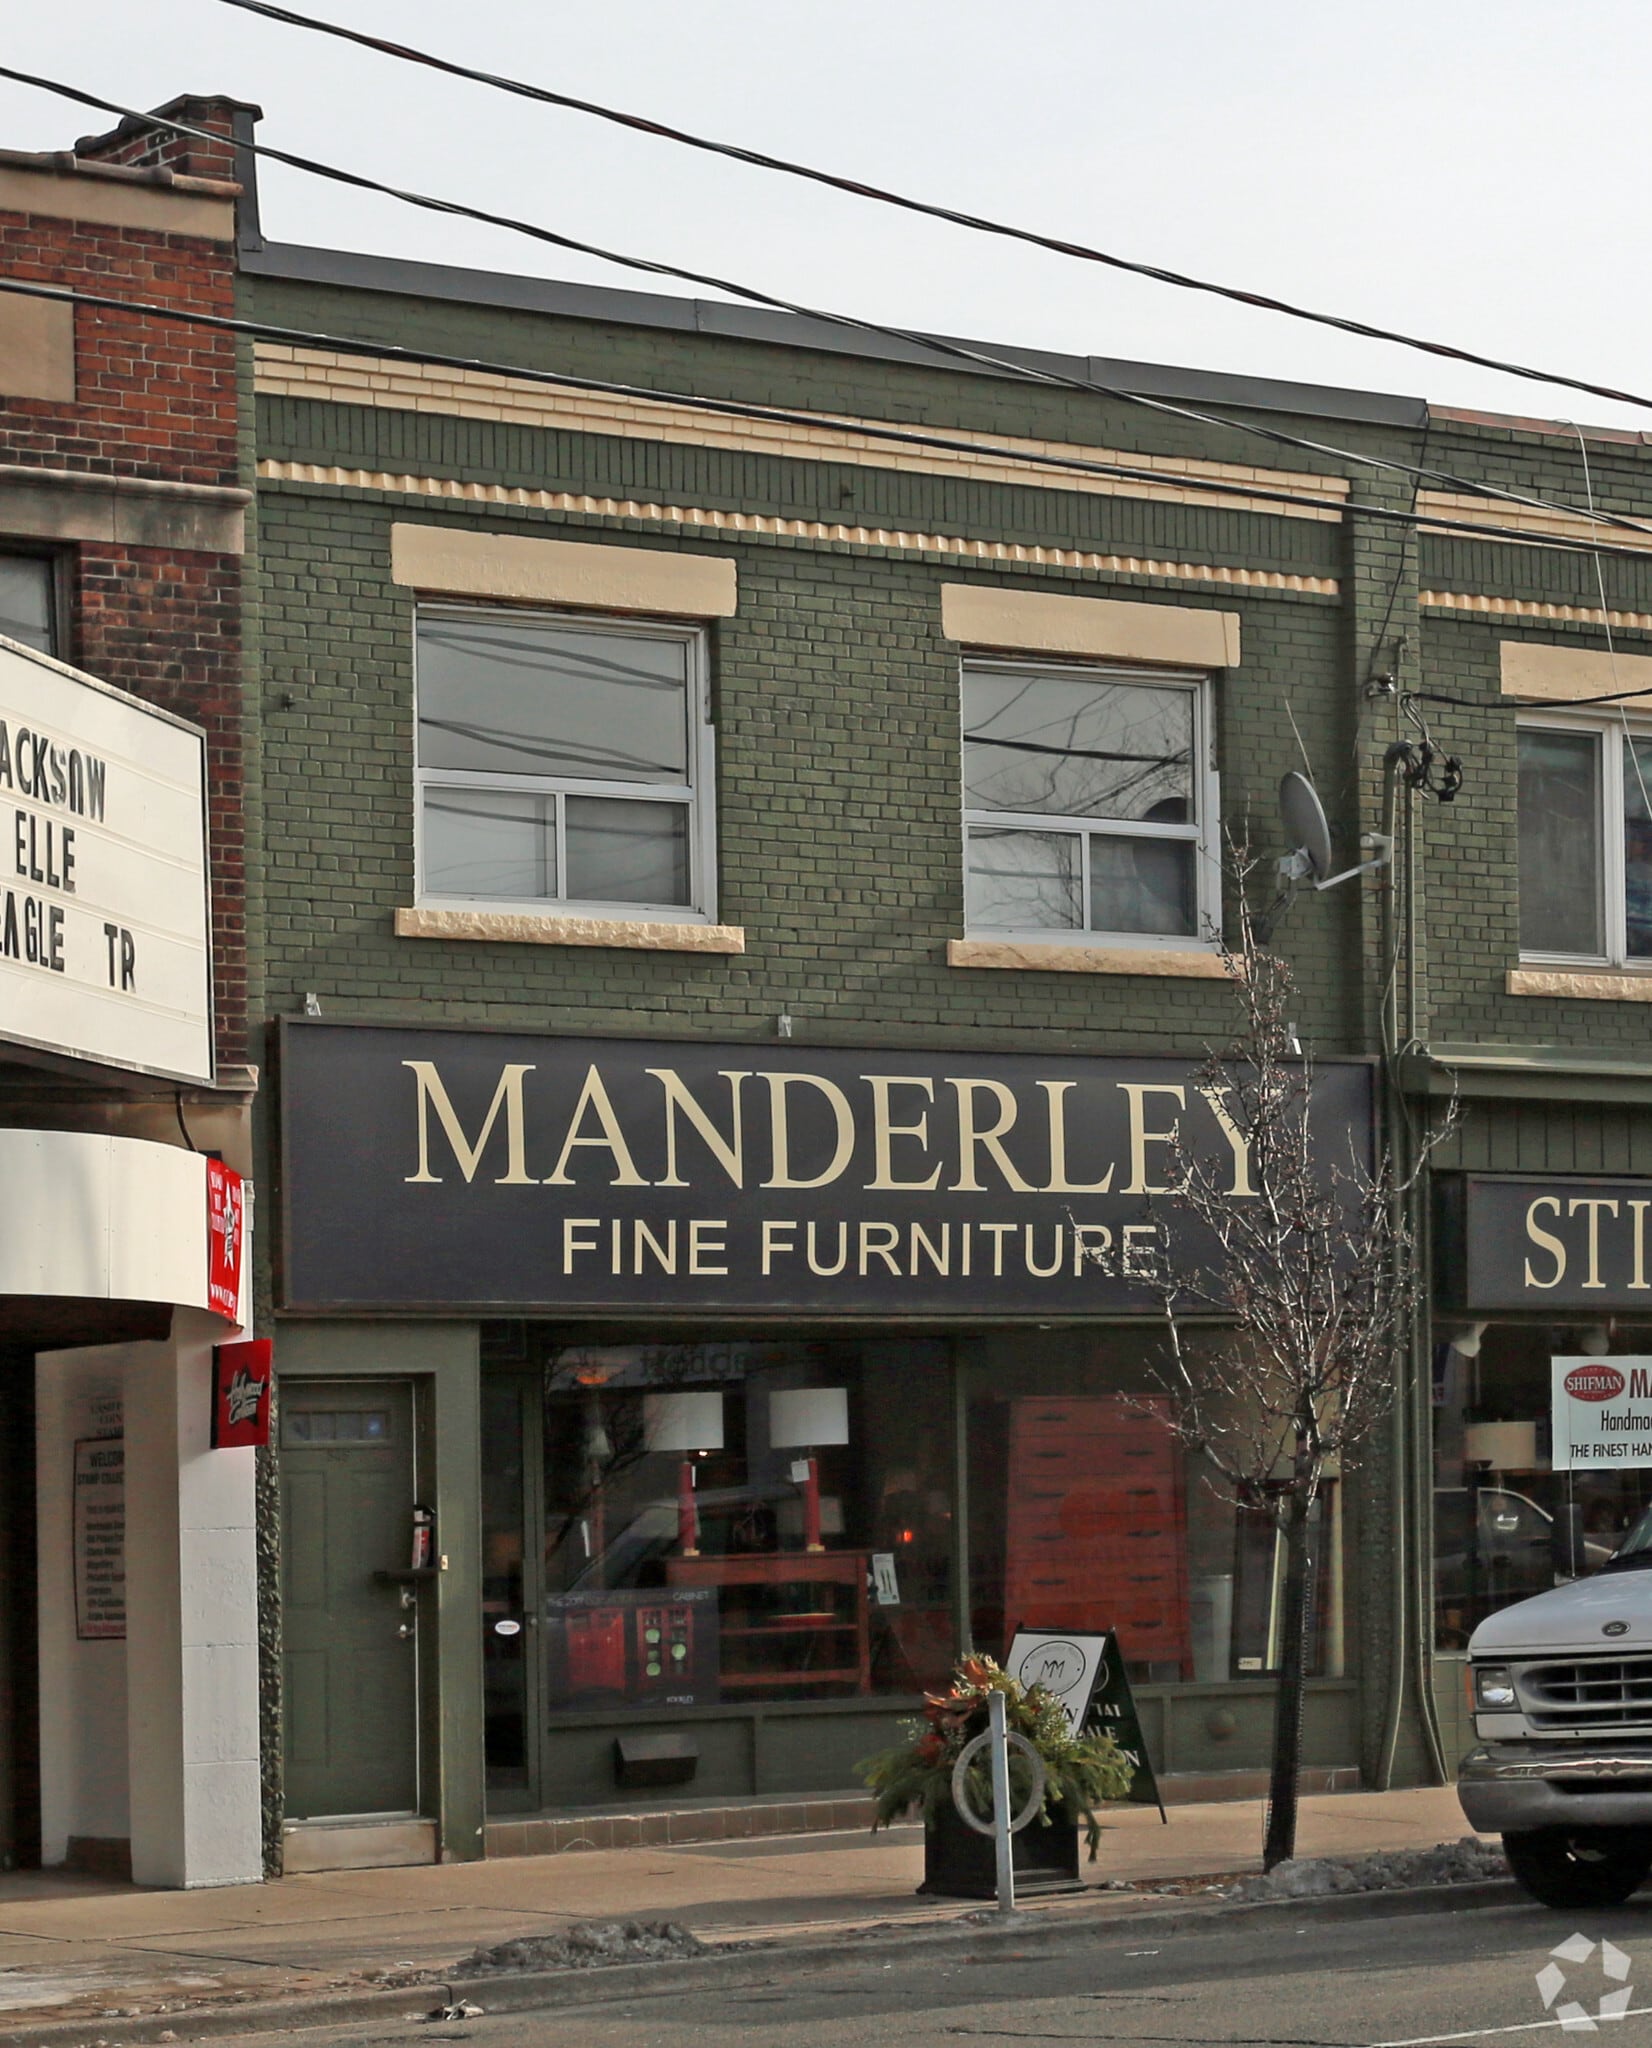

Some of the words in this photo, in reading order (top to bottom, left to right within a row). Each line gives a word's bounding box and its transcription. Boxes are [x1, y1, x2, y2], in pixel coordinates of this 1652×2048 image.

[16, 810, 76, 892] ELLE
[0, 888, 64, 973] AGLE
[104, 922, 136, 994] TR
[402, 1061, 1282, 1196] MANDERLEY
[564, 1219, 728, 1275] FINE
[762, 1221, 1157, 1278] FURNITURE
[1525, 1196, 1651, 1289] STI
[1567, 1375, 1622, 1391] SHIFMAN
[1570, 1444, 1589, 1458] THE
[1593, 1443, 1628, 1457] FINEST
[1601, 1407, 1652, 1431] Handma
